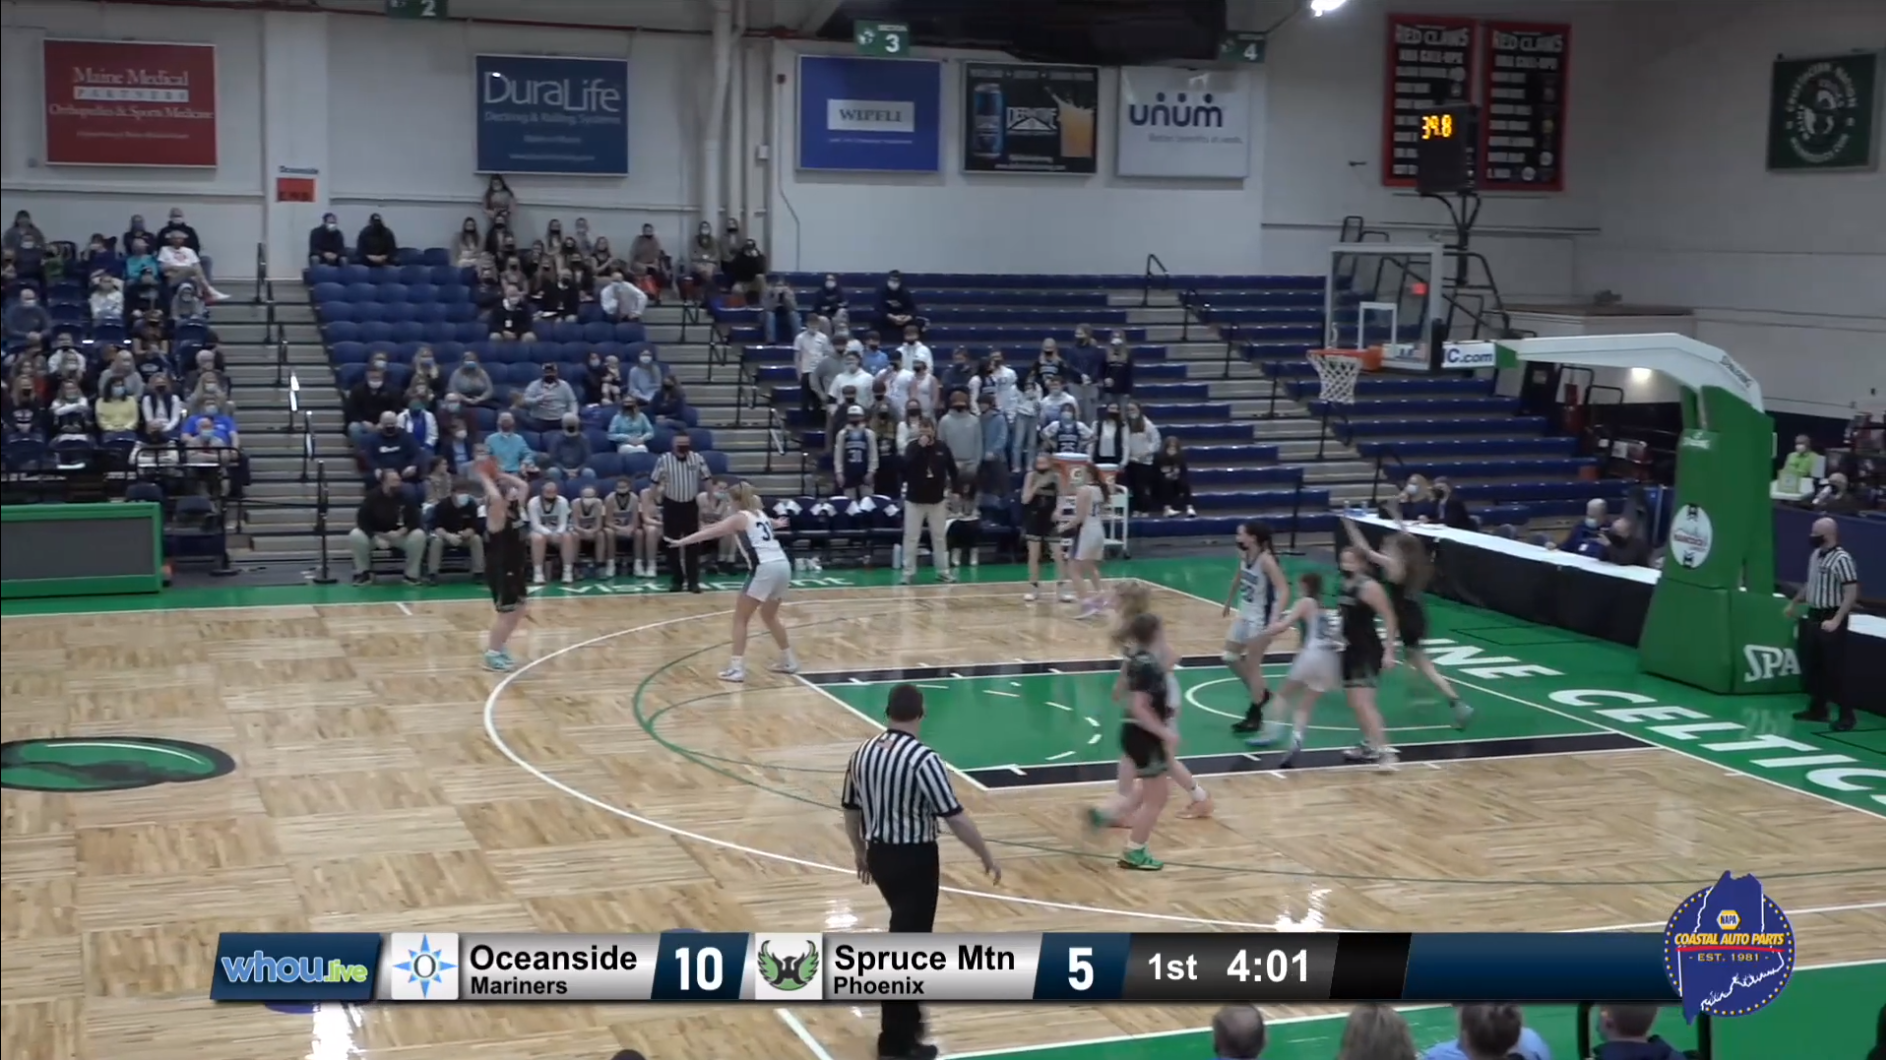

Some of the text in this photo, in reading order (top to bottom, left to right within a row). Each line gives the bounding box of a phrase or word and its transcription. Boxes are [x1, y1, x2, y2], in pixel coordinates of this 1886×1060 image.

[421, 0, 437, 16] 2
[885, 34, 900, 52] 3
[1243, 43, 1258, 60] 4
[73, 67, 189, 86] Maine Medical
[483, 71, 621, 112] DuraLife
[839, 109, 902, 122] WIPFLI
[1129, 103, 1223, 127] unum
[1548, 689, 1886, 805] CELTIC
